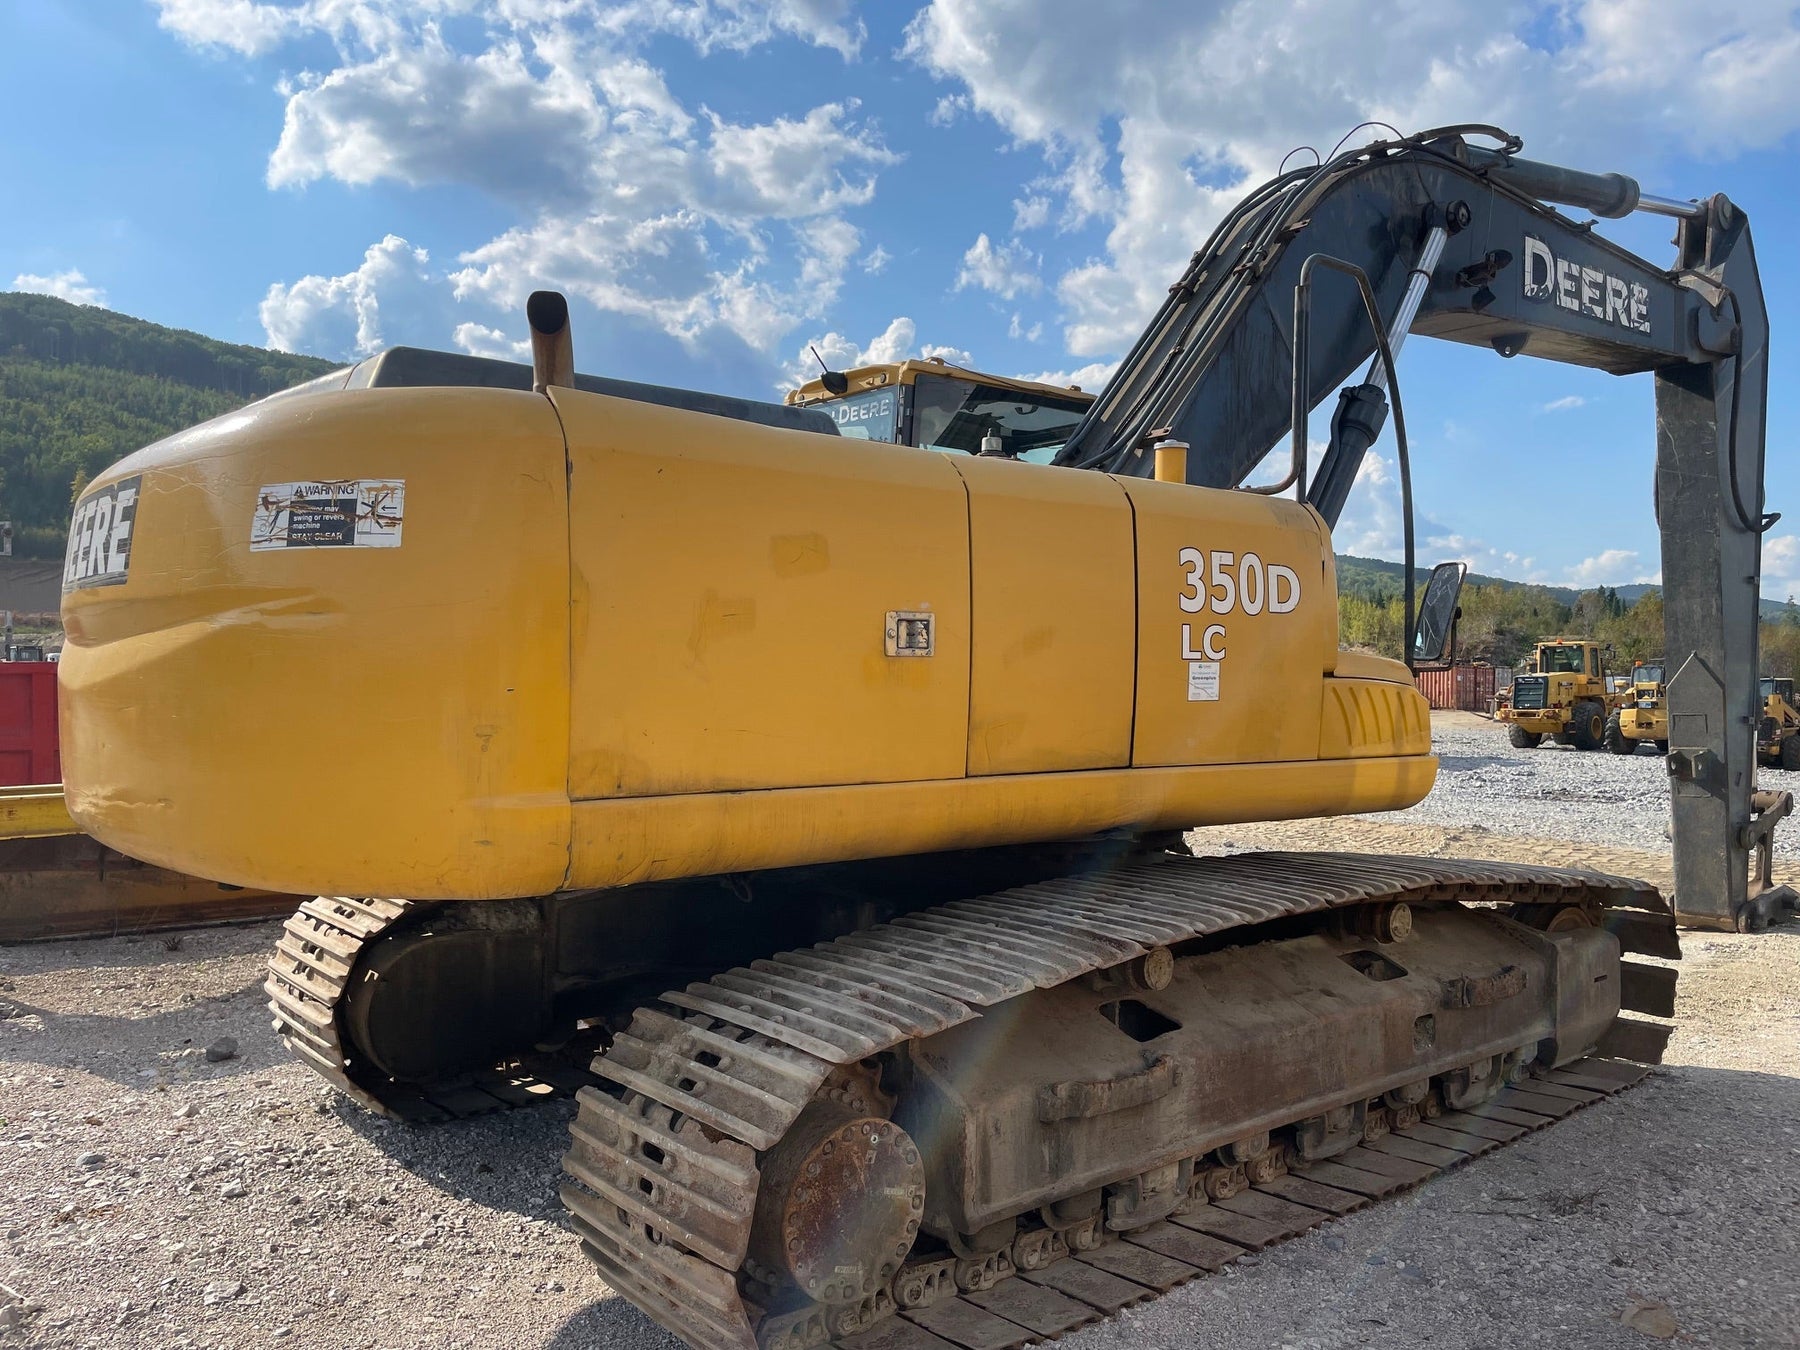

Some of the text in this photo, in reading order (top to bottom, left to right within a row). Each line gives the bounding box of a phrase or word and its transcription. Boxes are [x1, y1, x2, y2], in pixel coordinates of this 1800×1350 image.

[1525, 236, 1650, 333] DEERE
[839, 400, 889, 424] DEERE
[304, 485, 354, 495] WARNNG
[64, 488, 136, 583] EERE
[292, 532, 343, 541] STAY CLEAR
[1179, 547, 1301, 616] 350D
[1182, 623, 1226, 661] LC
